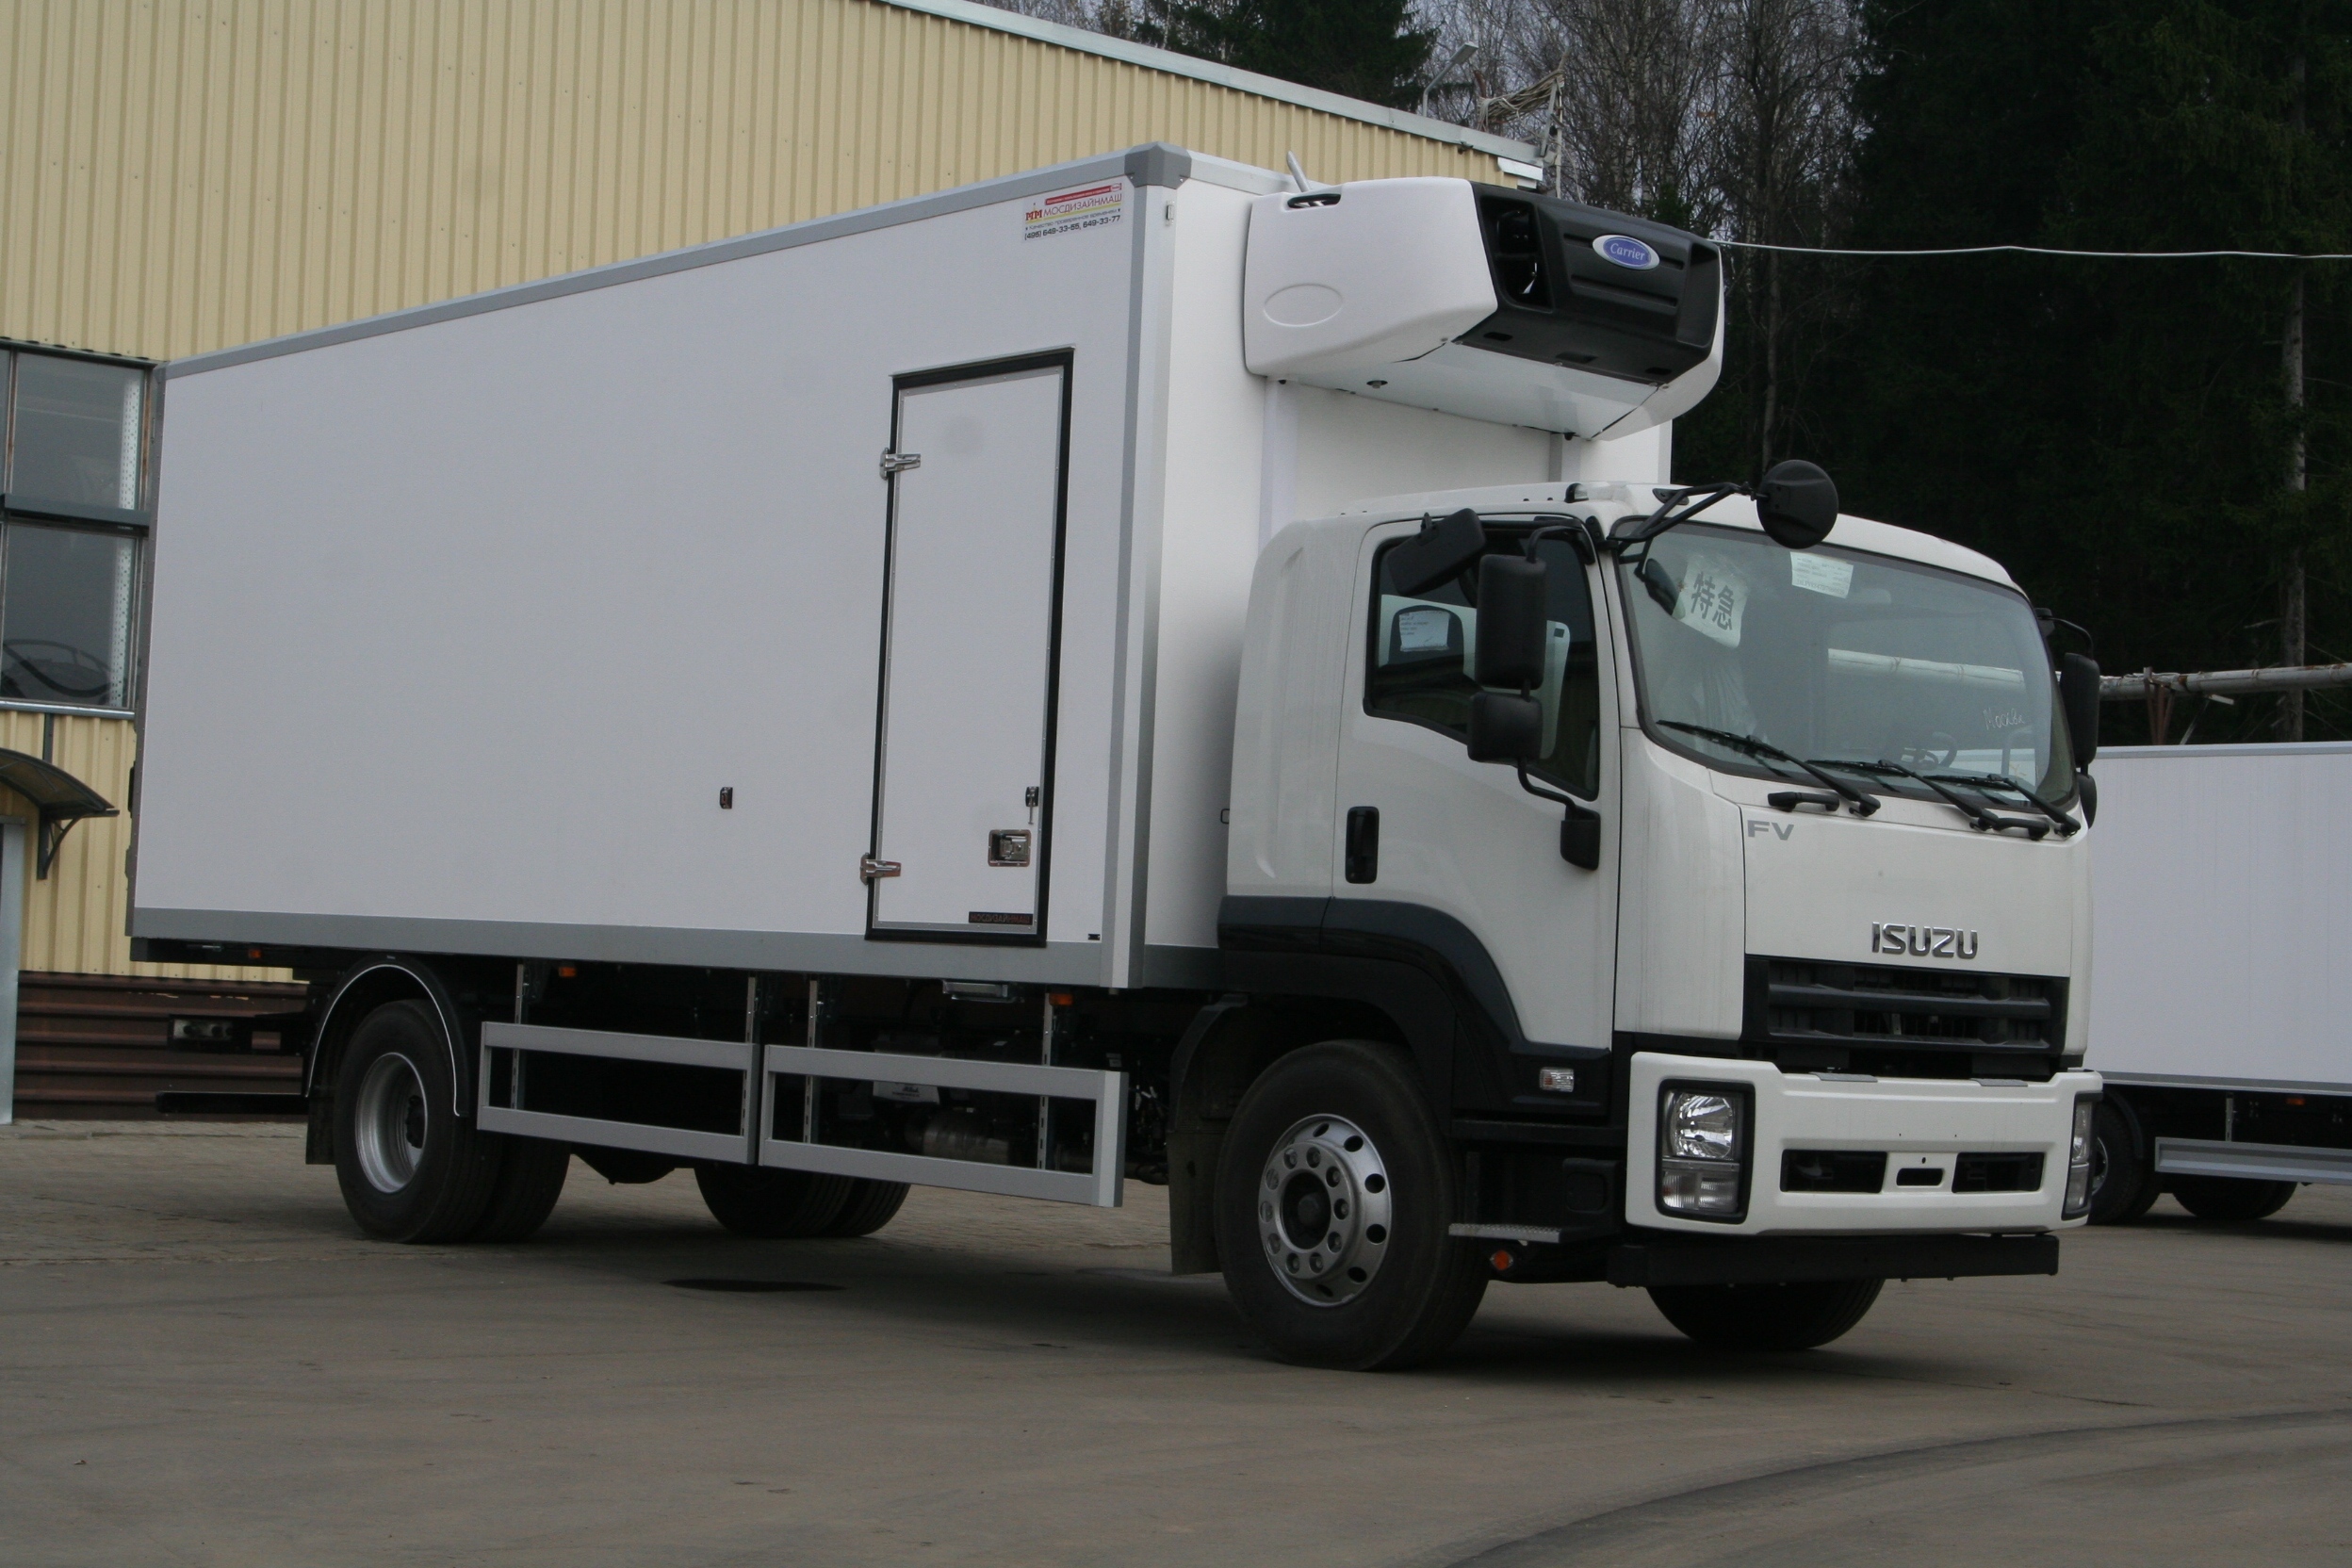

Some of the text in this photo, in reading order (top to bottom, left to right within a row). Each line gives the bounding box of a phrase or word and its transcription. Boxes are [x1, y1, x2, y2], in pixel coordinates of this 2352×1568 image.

[1043, 193, 1121, 216] МОСДИЗАЙНМАШ
[1083, 215, 1120, 228] 649-33-77
[1610, 243, 1644, 260] Carrier
[1690, 571, 1735, 630] 特急
[1747, 820, 1794, 841] FV
[1871, 921, 1978, 959] ISUZU
